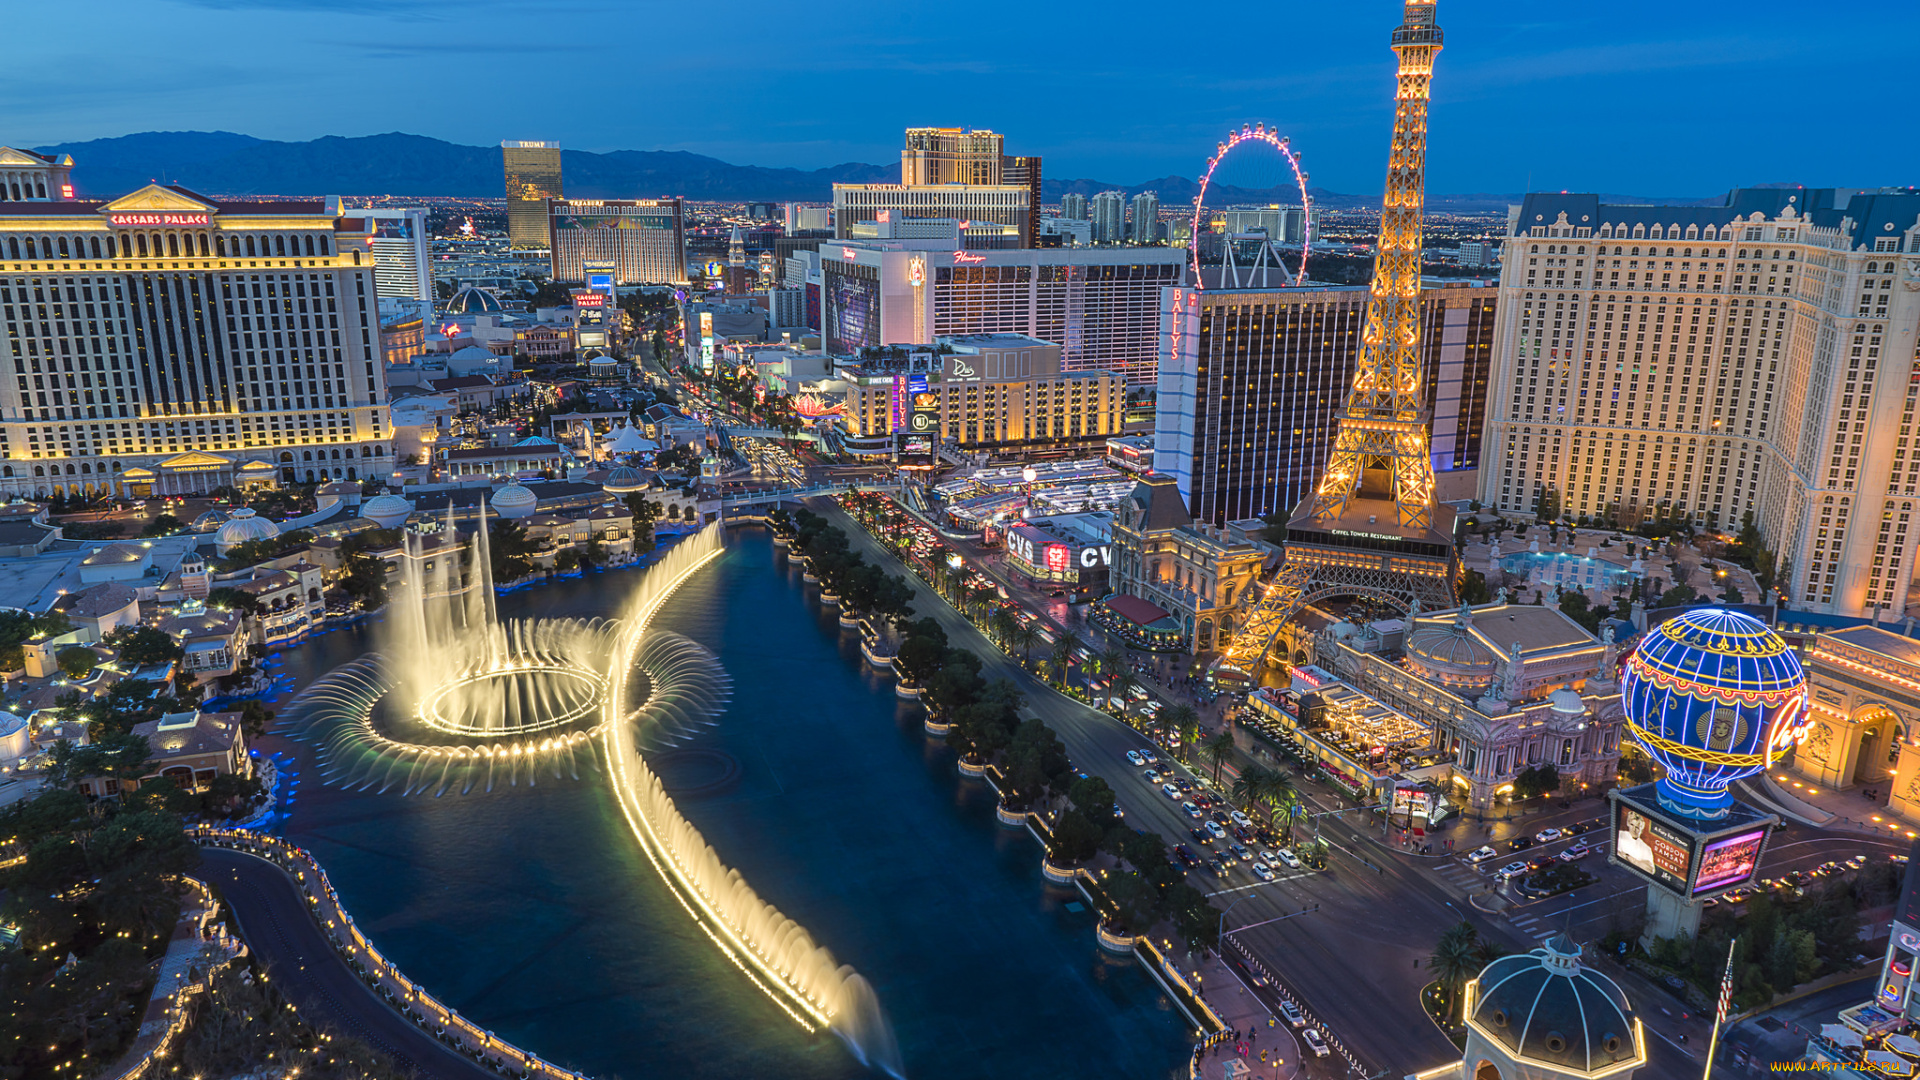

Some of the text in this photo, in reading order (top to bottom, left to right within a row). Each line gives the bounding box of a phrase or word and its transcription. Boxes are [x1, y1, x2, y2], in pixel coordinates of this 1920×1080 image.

[110, 214, 209, 225] CAESARS PALACE
[953, 250, 986, 264] Flamingo
[1007, 530, 1033, 561] CVS
[1369, 532, 1403, 541] RESTAURANT
[1292, 668, 1319, 687] BEER PARK
[1765, 695, 1816, 769] Paris
[1654, 846, 1684, 865] RAMSAY
[1655, 839, 1685, 859] GORDON
[1706, 845, 1753, 865] ANTHONY
[1703, 855, 1749, 875] COLS
